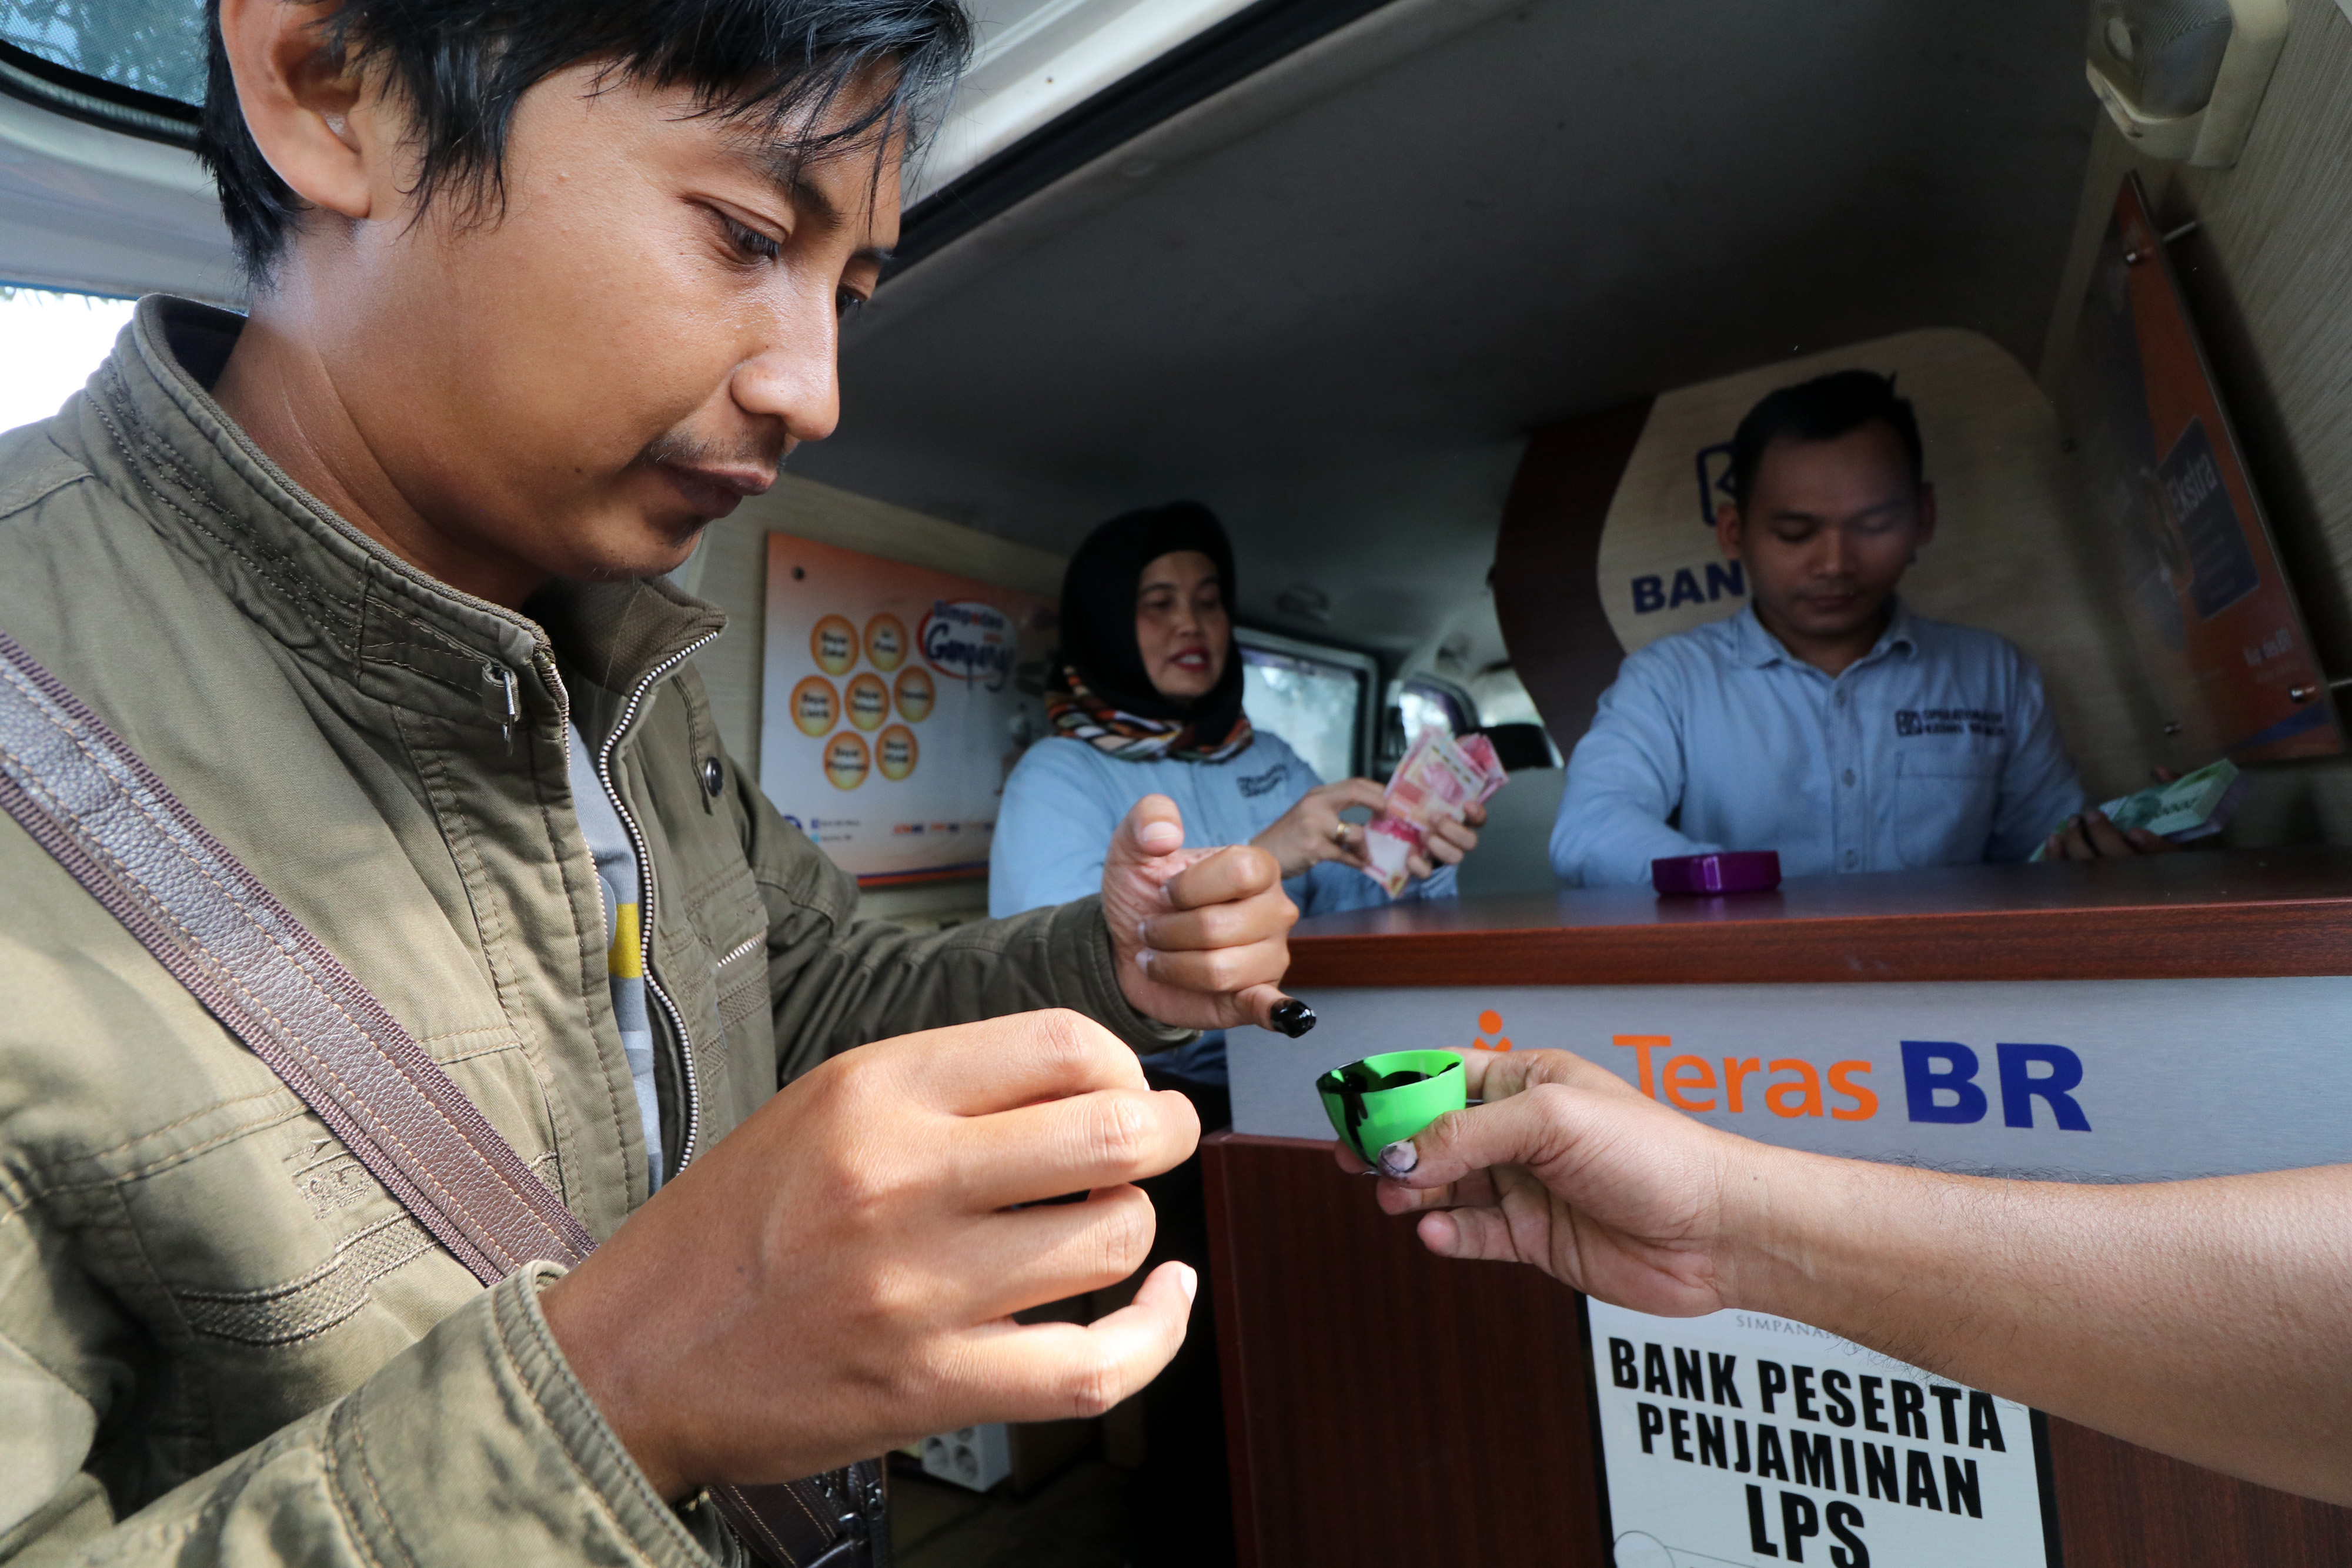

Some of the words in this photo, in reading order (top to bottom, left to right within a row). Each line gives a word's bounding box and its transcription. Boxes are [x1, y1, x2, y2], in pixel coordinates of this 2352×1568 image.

[1631, 560, 1745, 615] BAN
[1613, 1035, 1879, 1121] Teras
[1900, 1040, 2092, 1132] BR
[1609, 1337, 1743, 1409] BANK
[1757, 1359, 2007, 1453] PESERTA
[1637, 1402, 1983, 1519] PENJAMINAN
[1745, 1483, 1870, 1568] LPS
